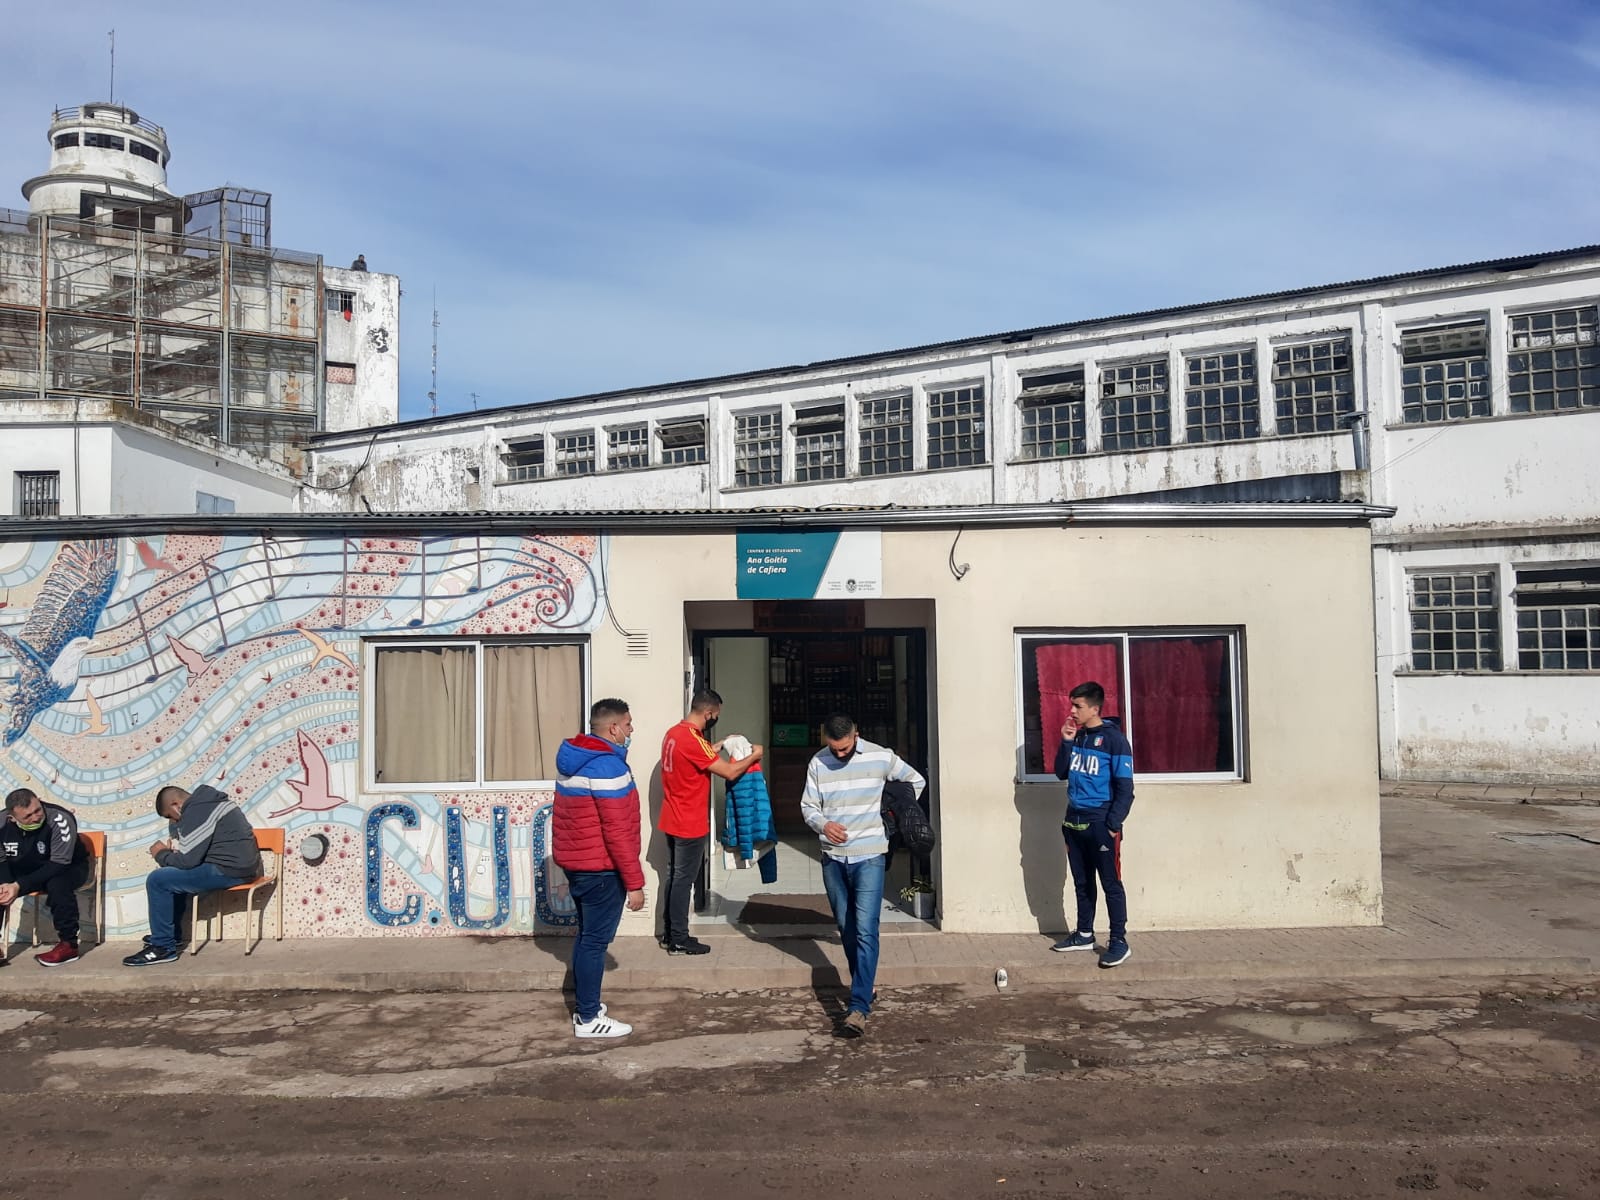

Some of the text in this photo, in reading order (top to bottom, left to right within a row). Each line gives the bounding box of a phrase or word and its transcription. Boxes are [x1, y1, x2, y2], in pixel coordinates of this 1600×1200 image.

[746, 555, 788, 564] Ana Goitía
[747, 565, 787, 575] de Cafiero
